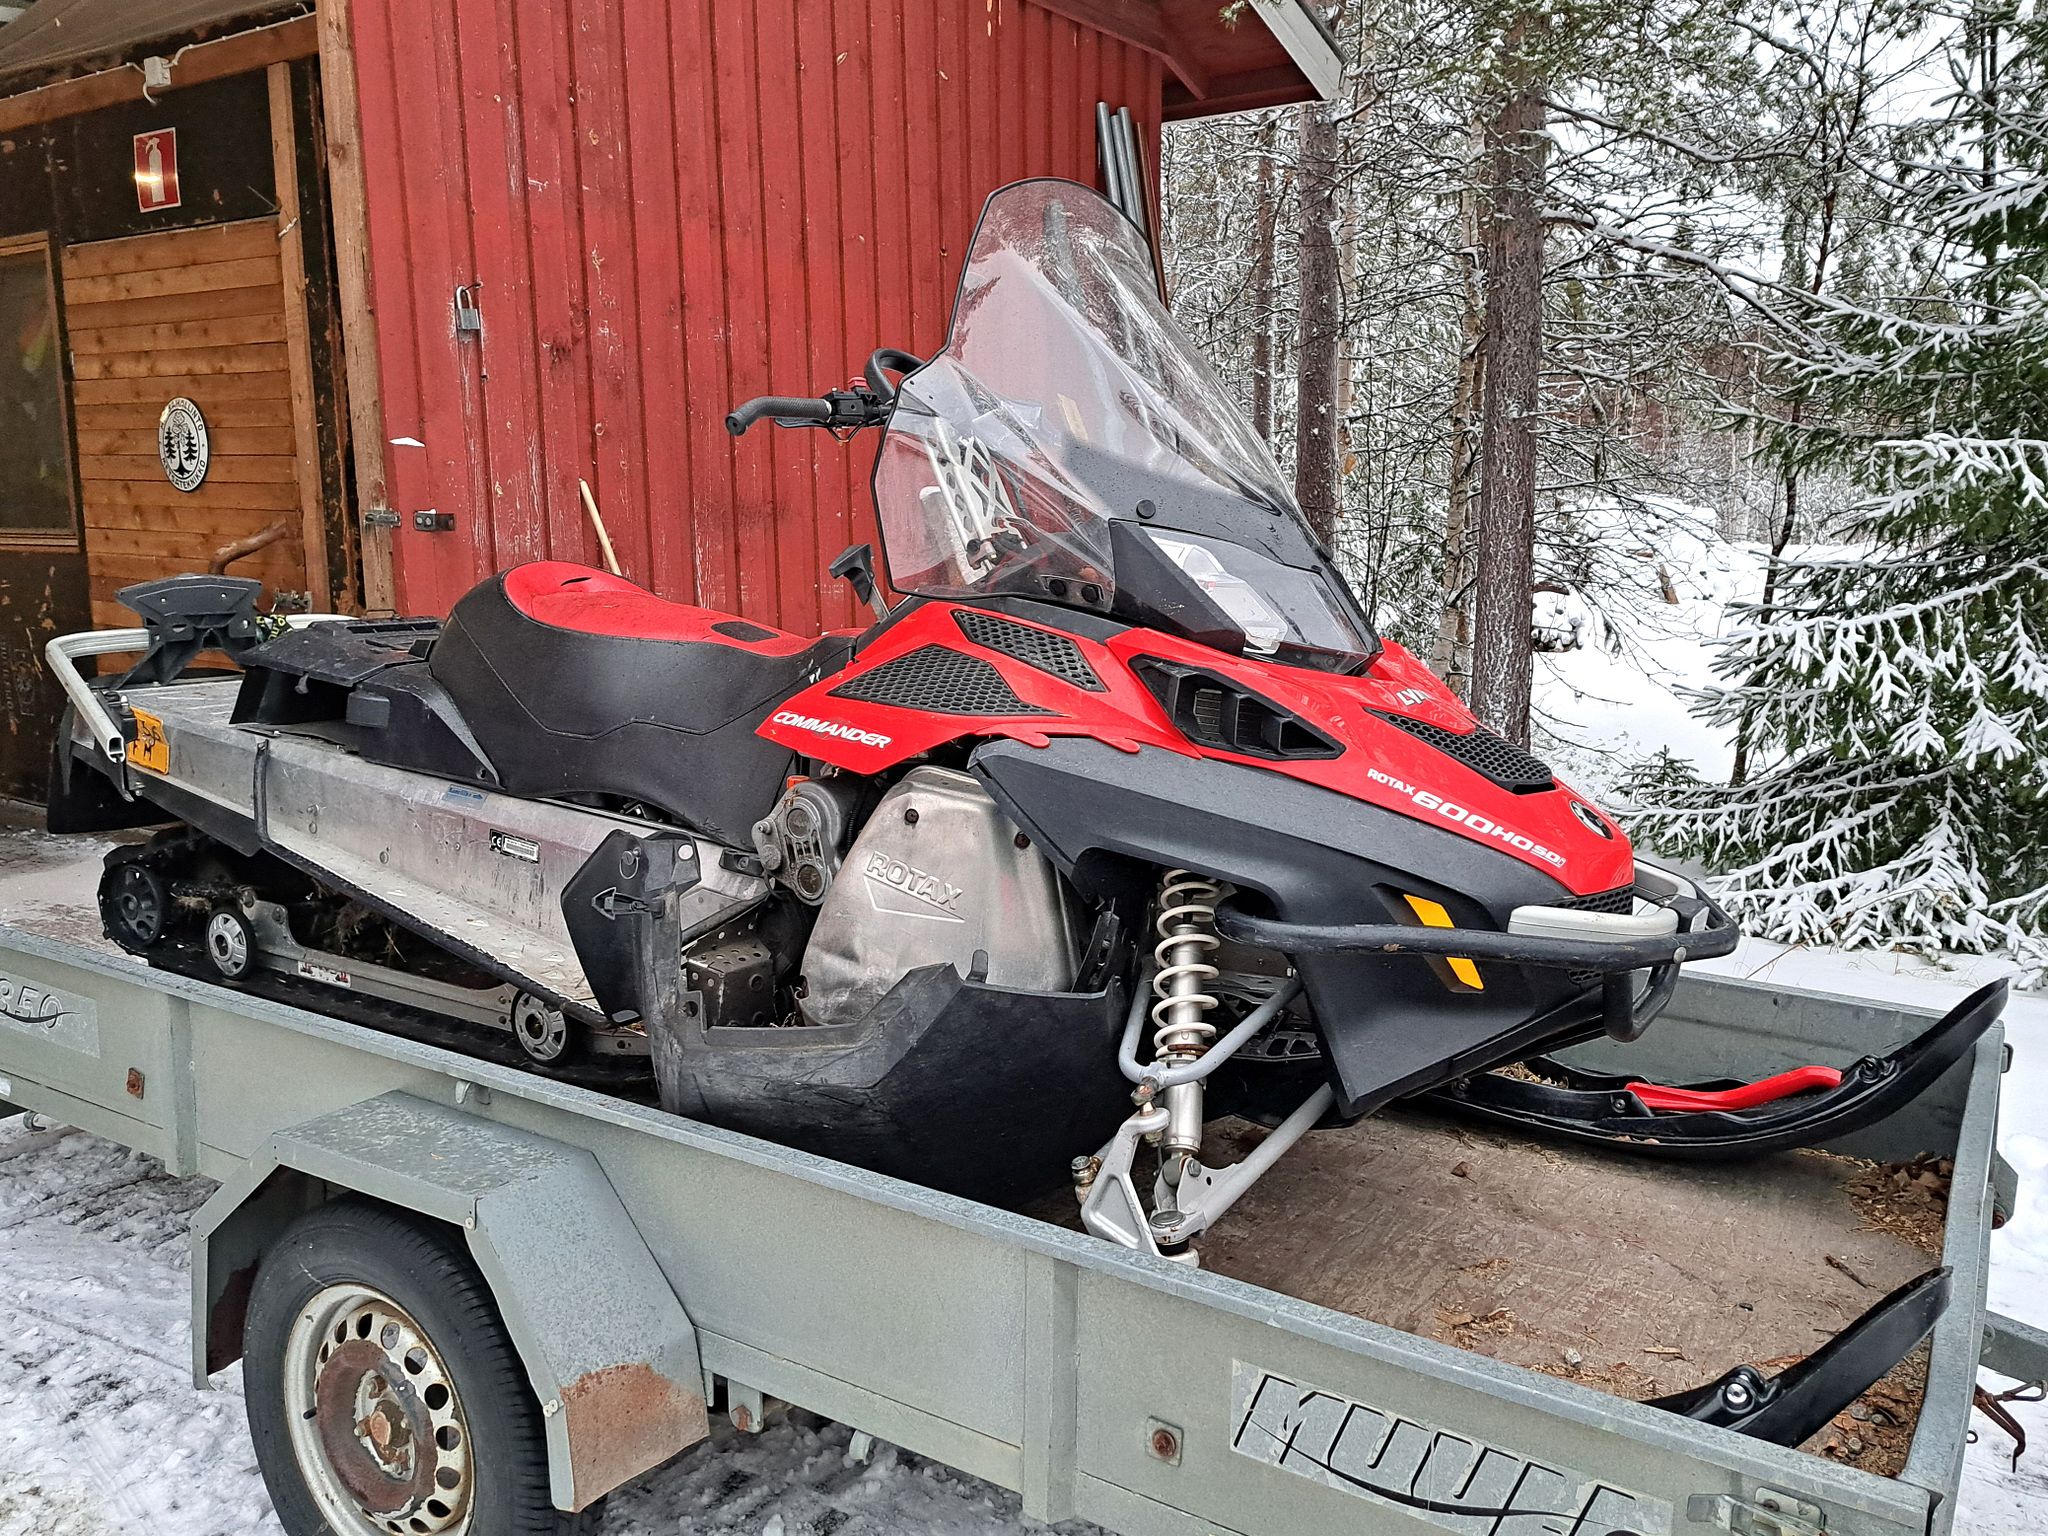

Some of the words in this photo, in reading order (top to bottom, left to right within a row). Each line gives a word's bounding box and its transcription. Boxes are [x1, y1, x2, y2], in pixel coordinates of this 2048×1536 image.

[772, 701, 892, 749] COMMANDER
[1367, 767, 1416, 796] ROTAX
[866, 850, 963, 911] ROTAX
